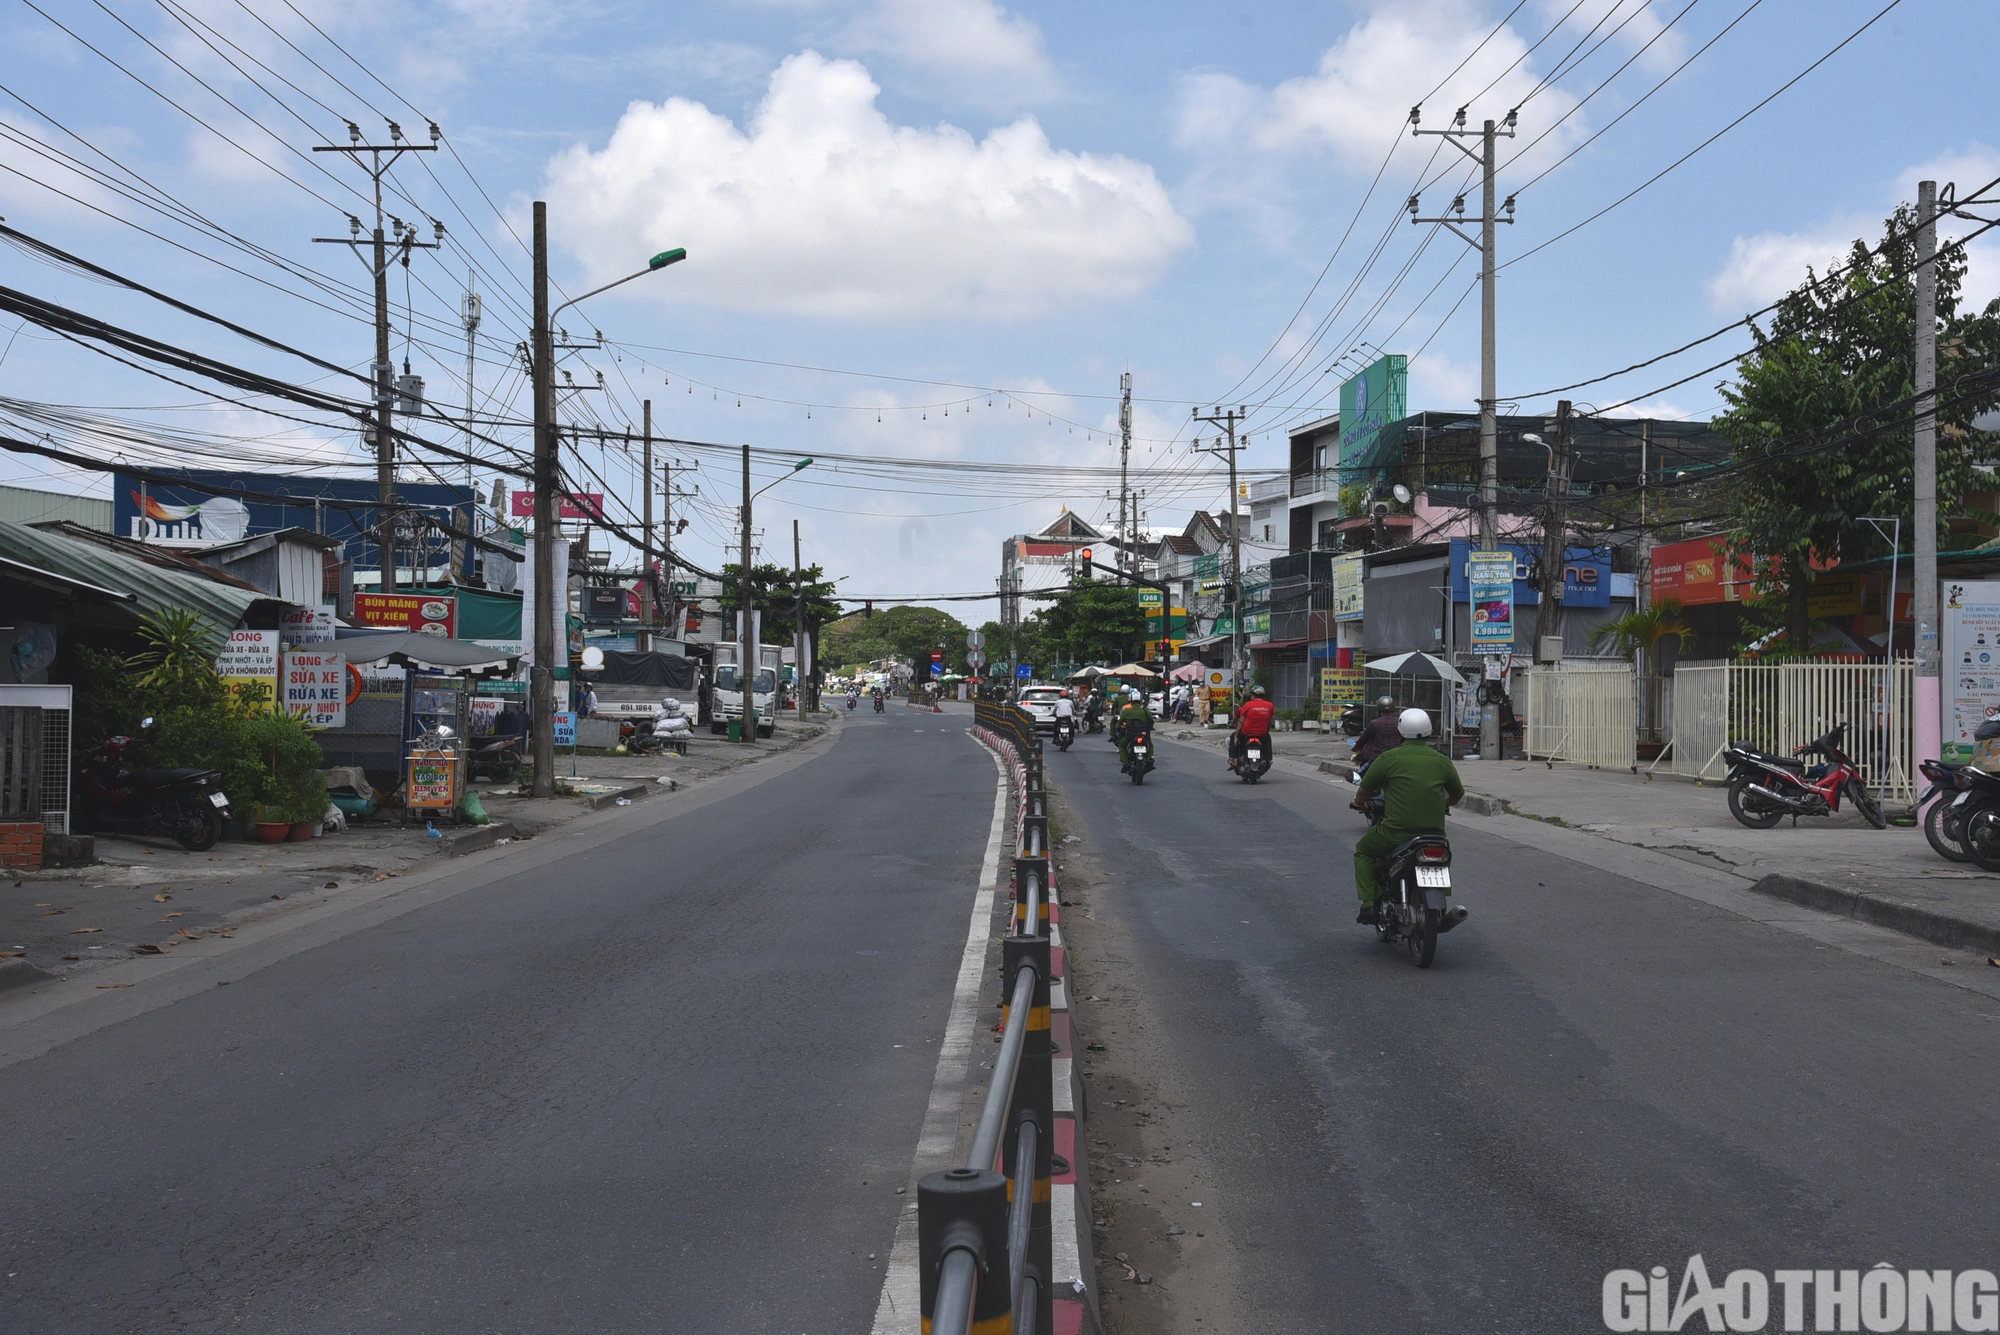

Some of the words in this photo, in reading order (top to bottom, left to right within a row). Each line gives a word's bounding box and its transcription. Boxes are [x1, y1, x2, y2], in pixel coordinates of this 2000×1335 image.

[365, 597, 385, 607] BÚN
[389, 599, 418, 609] MĂNG
[366, 611, 380, 621] VỊT
[384, 611, 408, 621] XIÊM
[230, 632, 263, 642] LONG
[248, 644, 260, 653] RỬA
[292, 656, 321, 666] LONG
[236, 665, 258, 674] KHÔNG
[290, 667, 316, 684] SỬA
[322, 671, 339, 684] XE
[289, 685, 317, 700] RỬA
[321, 688, 339, 700] XE
[317, 700, 341, 713] NHỚT
[1422, 877, 1445, 885] 1111
